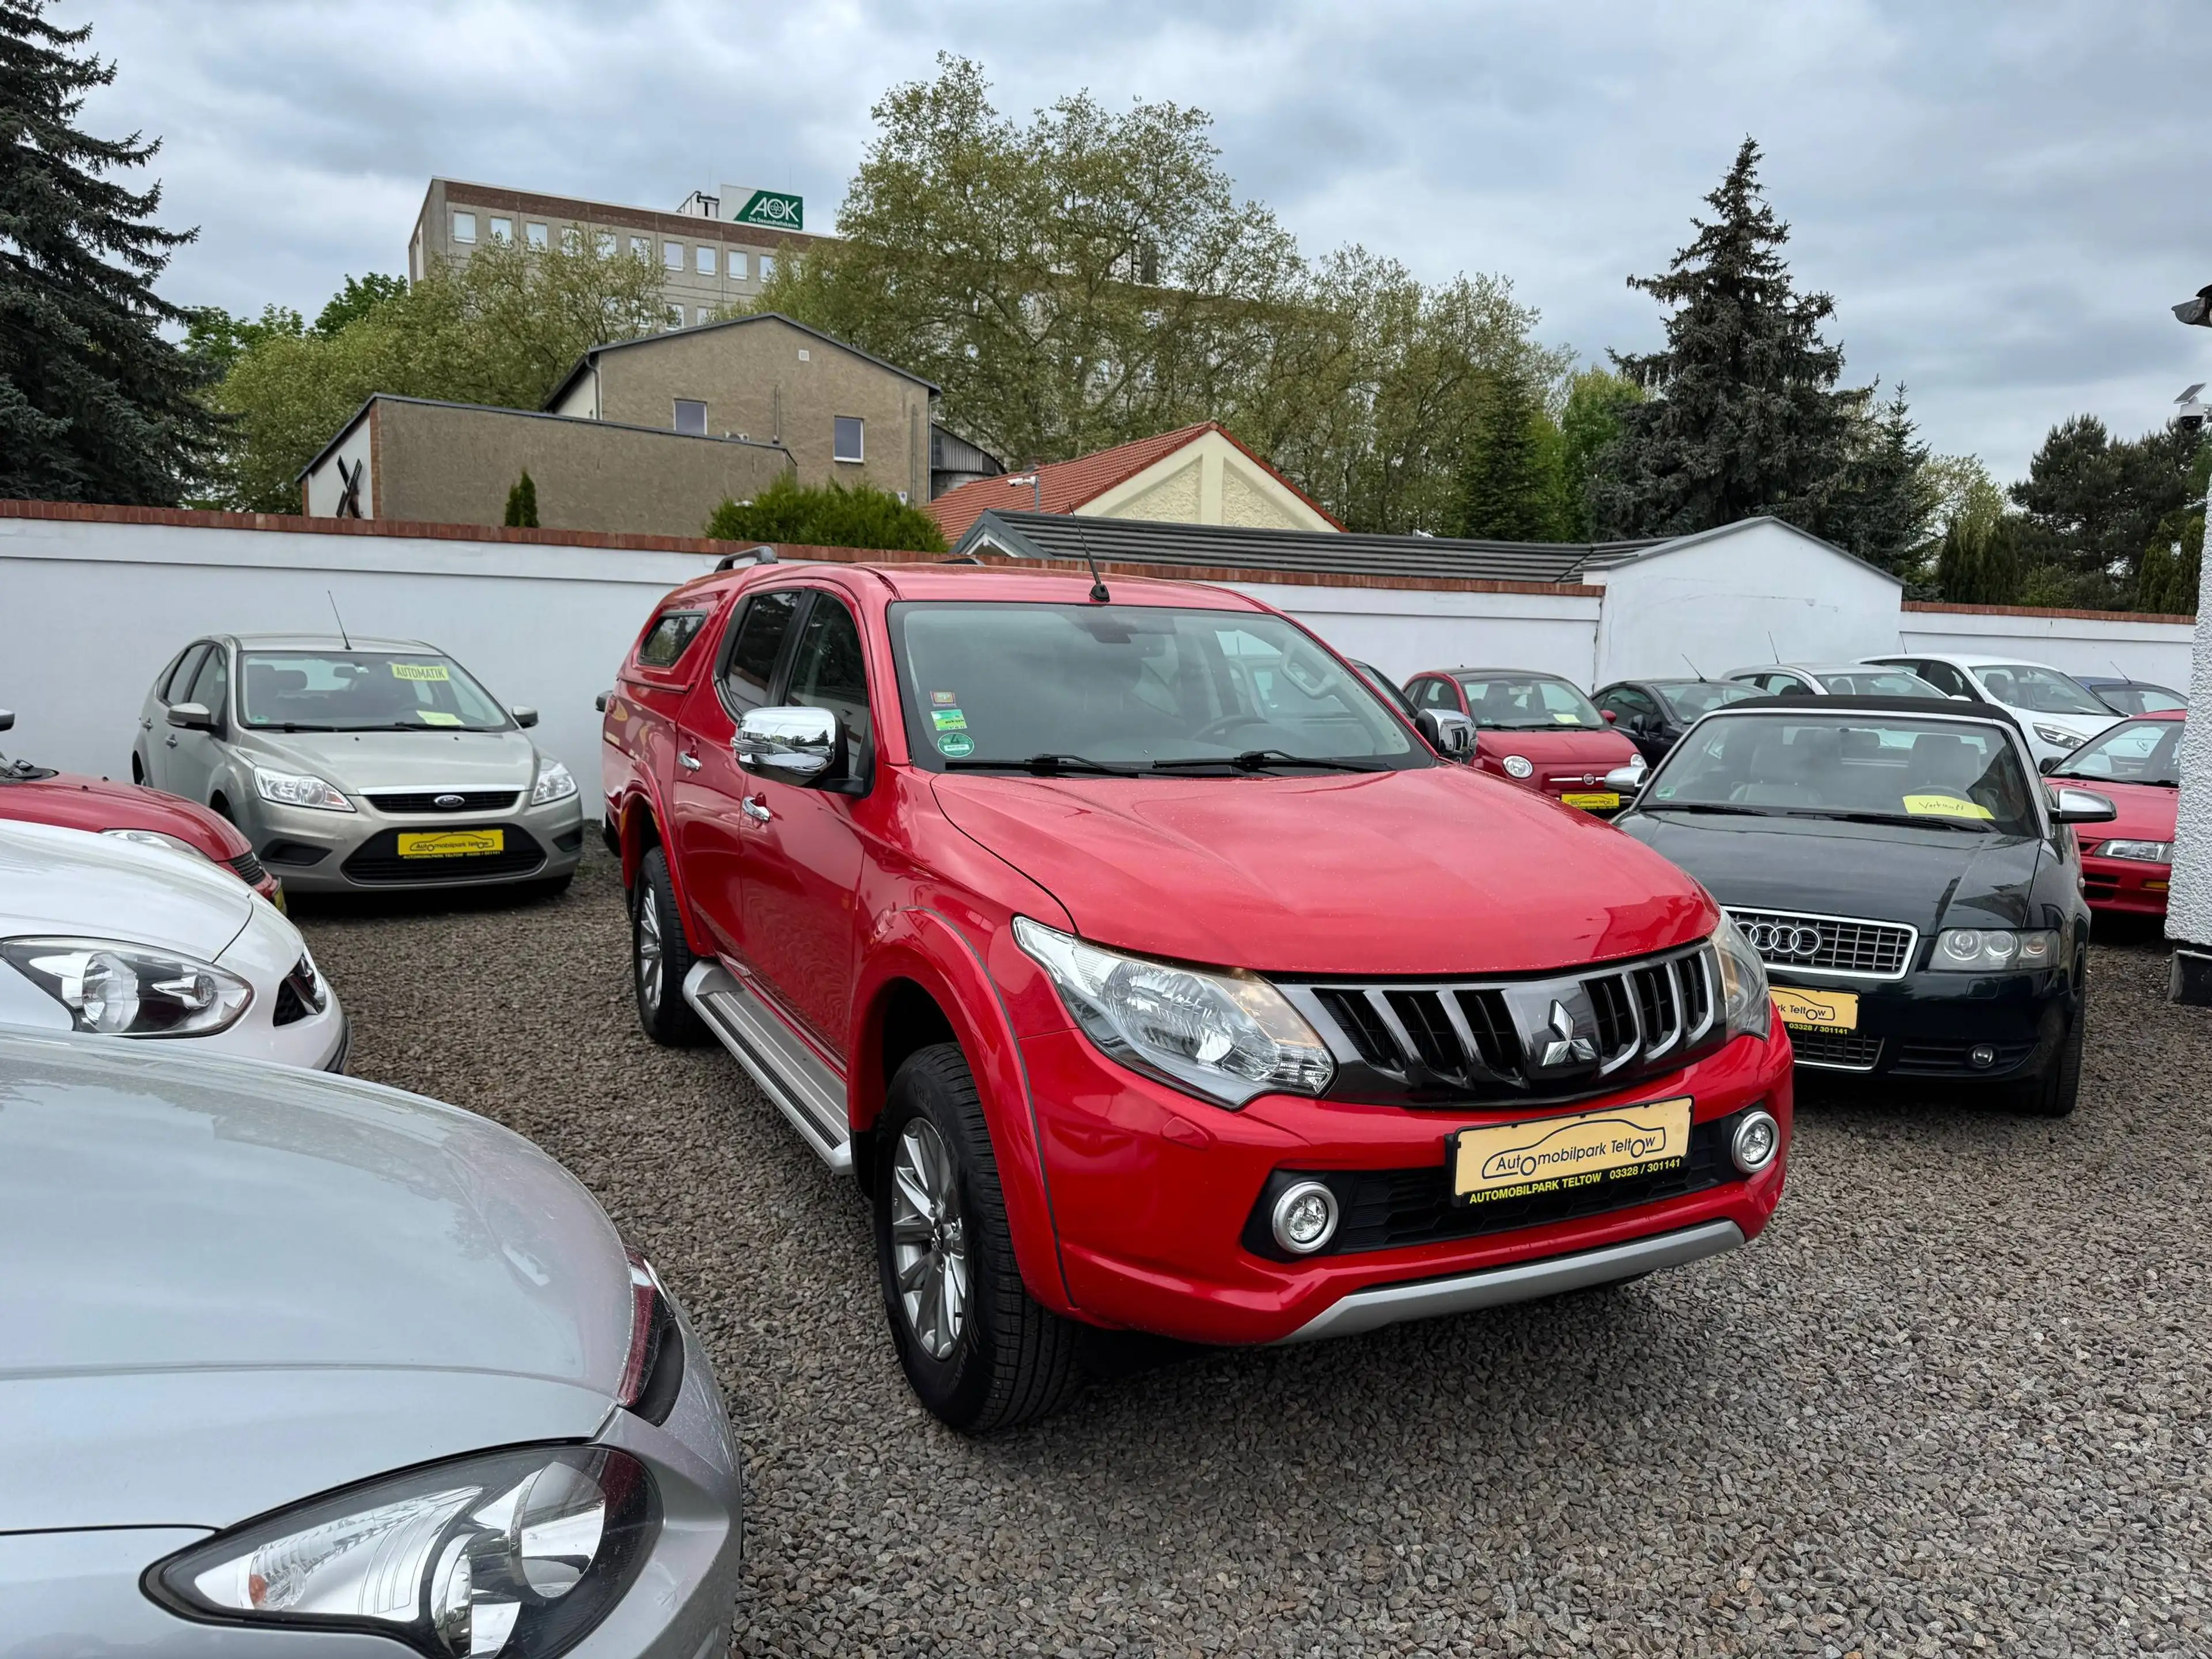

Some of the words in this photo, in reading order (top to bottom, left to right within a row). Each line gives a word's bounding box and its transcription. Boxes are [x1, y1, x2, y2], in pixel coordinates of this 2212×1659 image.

[750, 197, 799, 222] AOK
[396, 667, 446, 679] AUTOMATIK
[1789, 1023, 1812, 1031] 03328
[1819, 1026, 1848, 1035] 301141
[1469, 1180, 1559, 1205] AUTOMOBILPARK
[1562, 1172, 1602, 1188] TELTOW
[1609, 1166, 1638, 1180] 03328
[1647, 1158, 1681, 1173] 301141
